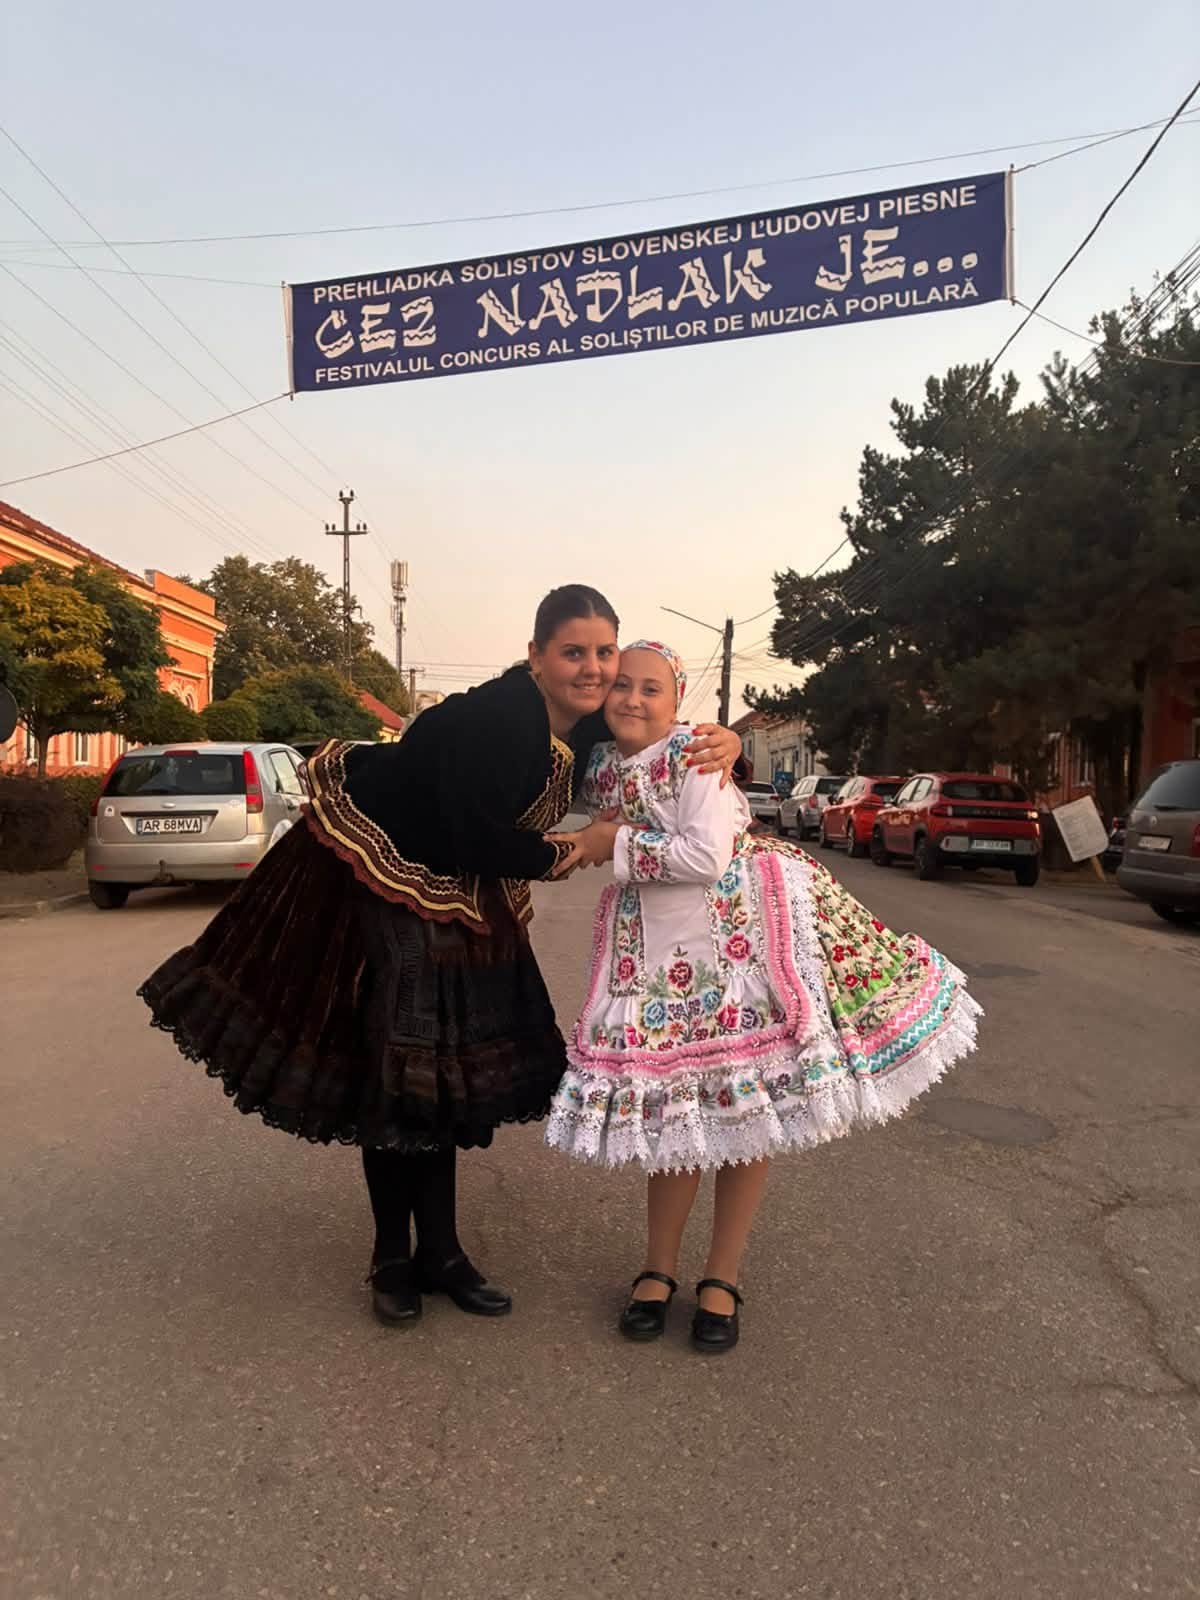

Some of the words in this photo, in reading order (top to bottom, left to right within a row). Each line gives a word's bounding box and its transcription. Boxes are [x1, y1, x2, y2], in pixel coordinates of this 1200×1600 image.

[313, 269, 455, 305] PREHLIADKA
[460, 250, 576, 283] SOLISTOV
[581, 223, 743, 265] SLOVENSKEJ
[751, 202, 870, 239] ĽUDOVEJ
[879, 184, 977, 219] PIESNE
[476, 247, 773, 340] NADLAK
[814, 226, 979, 293] JE...
[315, 356, 436, 384] FESTIVALUL
[439, 342, 541, 370] CONCURS
[546, 338, 576, 356] AL
[580, 319, 708, 352] SOLIȘTILOR
[714, 314, 745, 334] DE
[750, 297, 840, 329] MUZICĂ
[845, 277, 979, 316] POPULARĂ
[143, 820, 160, 831] AR
